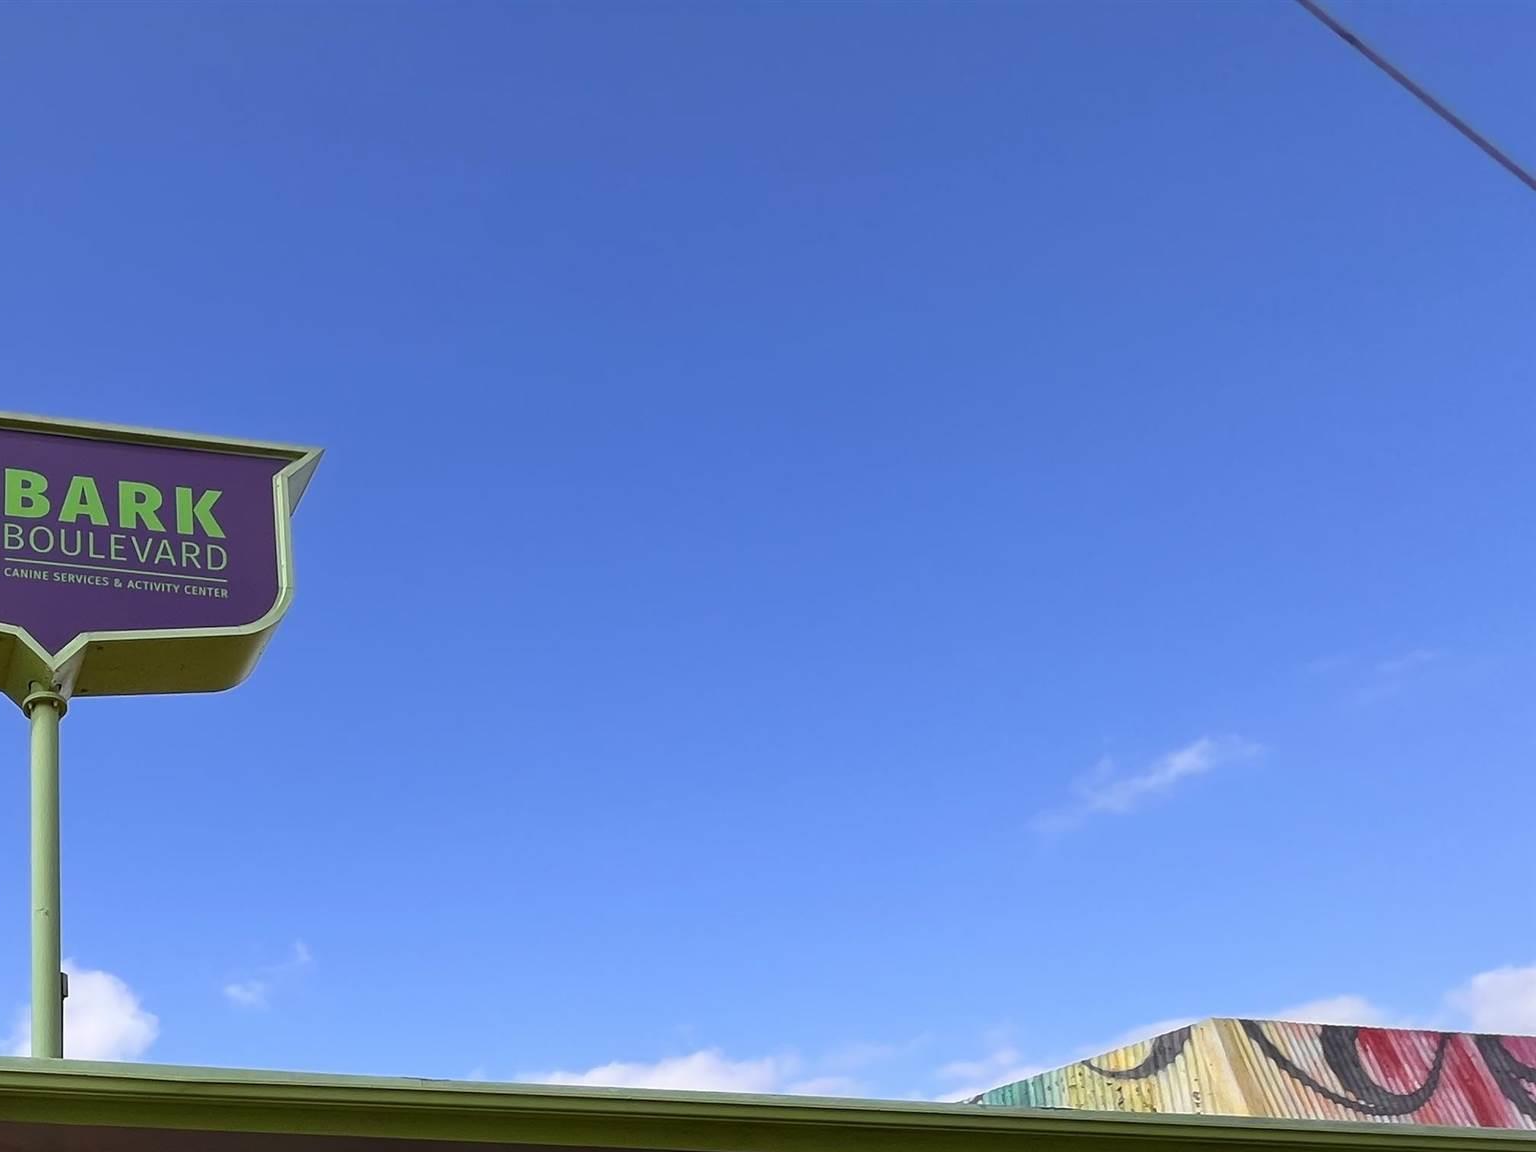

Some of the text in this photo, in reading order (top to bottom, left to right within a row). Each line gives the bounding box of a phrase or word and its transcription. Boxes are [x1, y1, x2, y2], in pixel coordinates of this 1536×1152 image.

[4, 467, 226, 539] BARK
[4, 523, 227, 571] BOULEVARD
[4, 567, 229, 598] CANINE SERVICES & ACTIVITY CENTER
